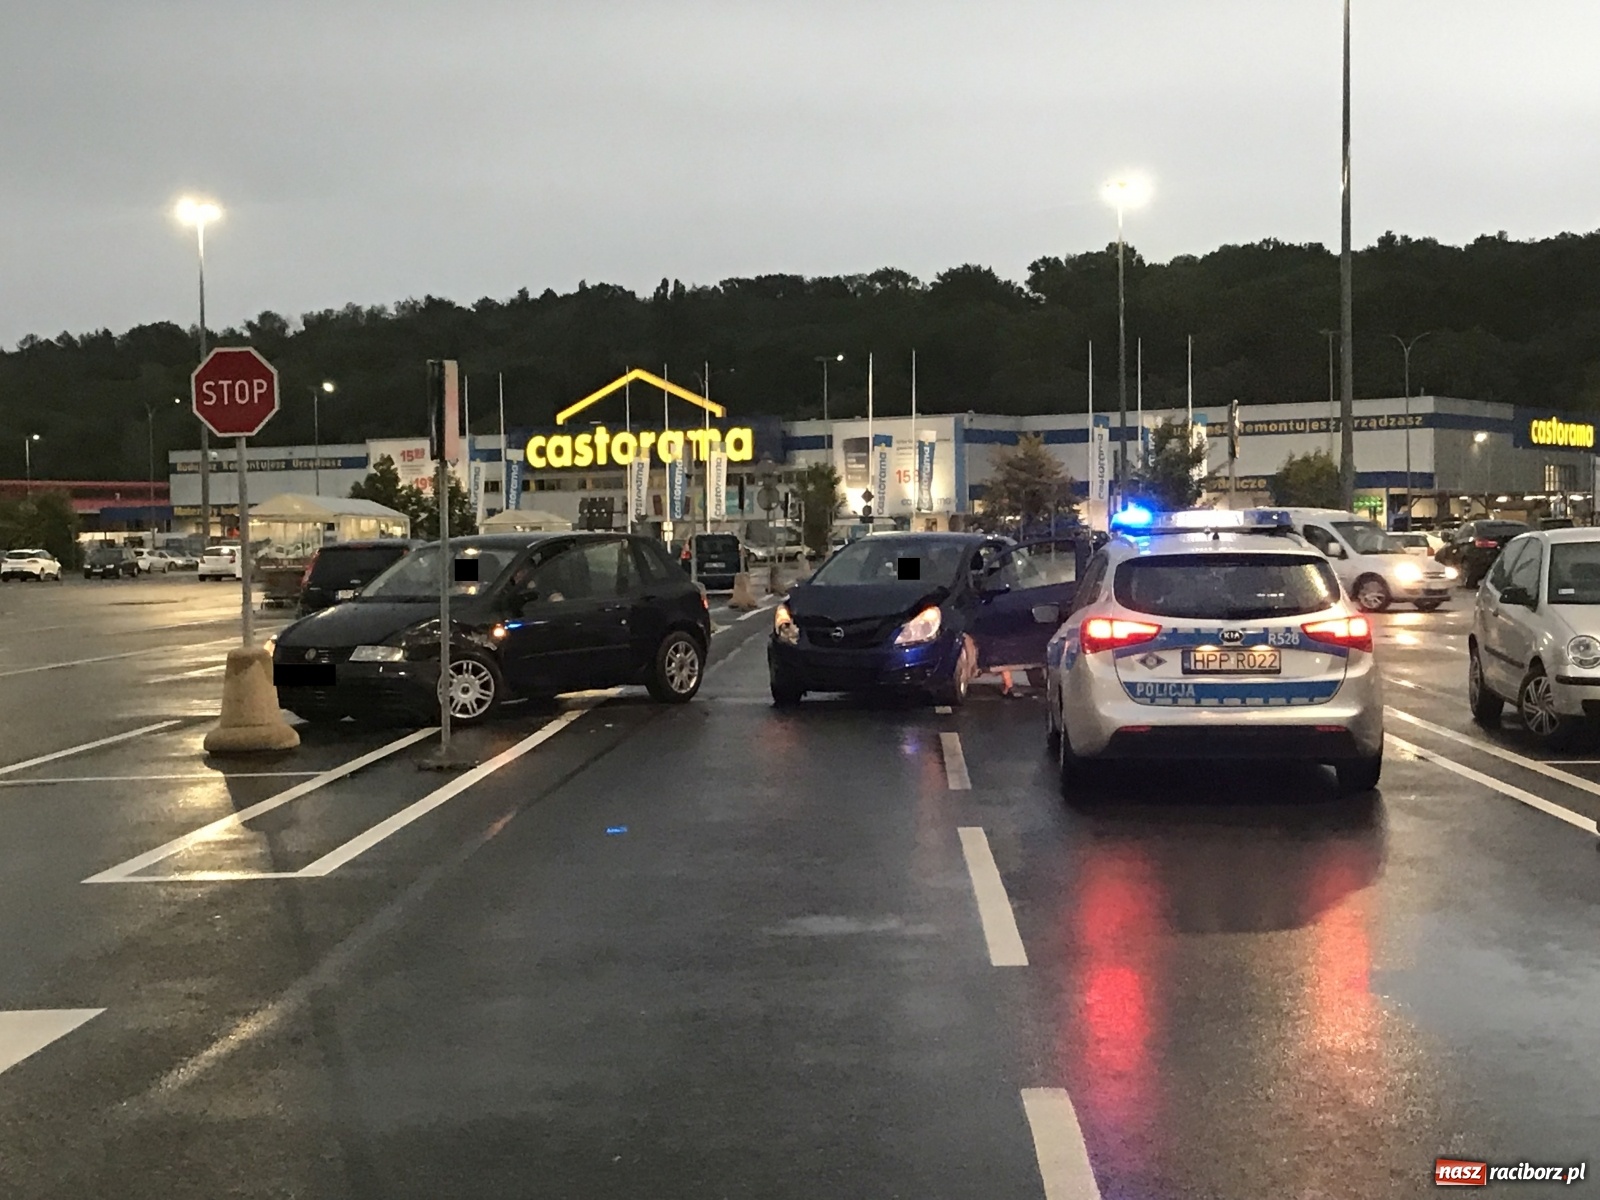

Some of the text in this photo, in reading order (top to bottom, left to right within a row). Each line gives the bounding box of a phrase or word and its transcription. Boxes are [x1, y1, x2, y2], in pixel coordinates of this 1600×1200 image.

[202, 379, 268, 405] STOP
[1531, 415, 1594, 448] castorama
[526, 426, 753, 469] castorama
[673, 459, 684, 519] castorama
[876, 452, 887, 516] castorama
[1267, 632, 1300, 645] R528
[1193, 653, 1278, 669] HPP R022
[1136, 683, 1195, 698] POLICJA
